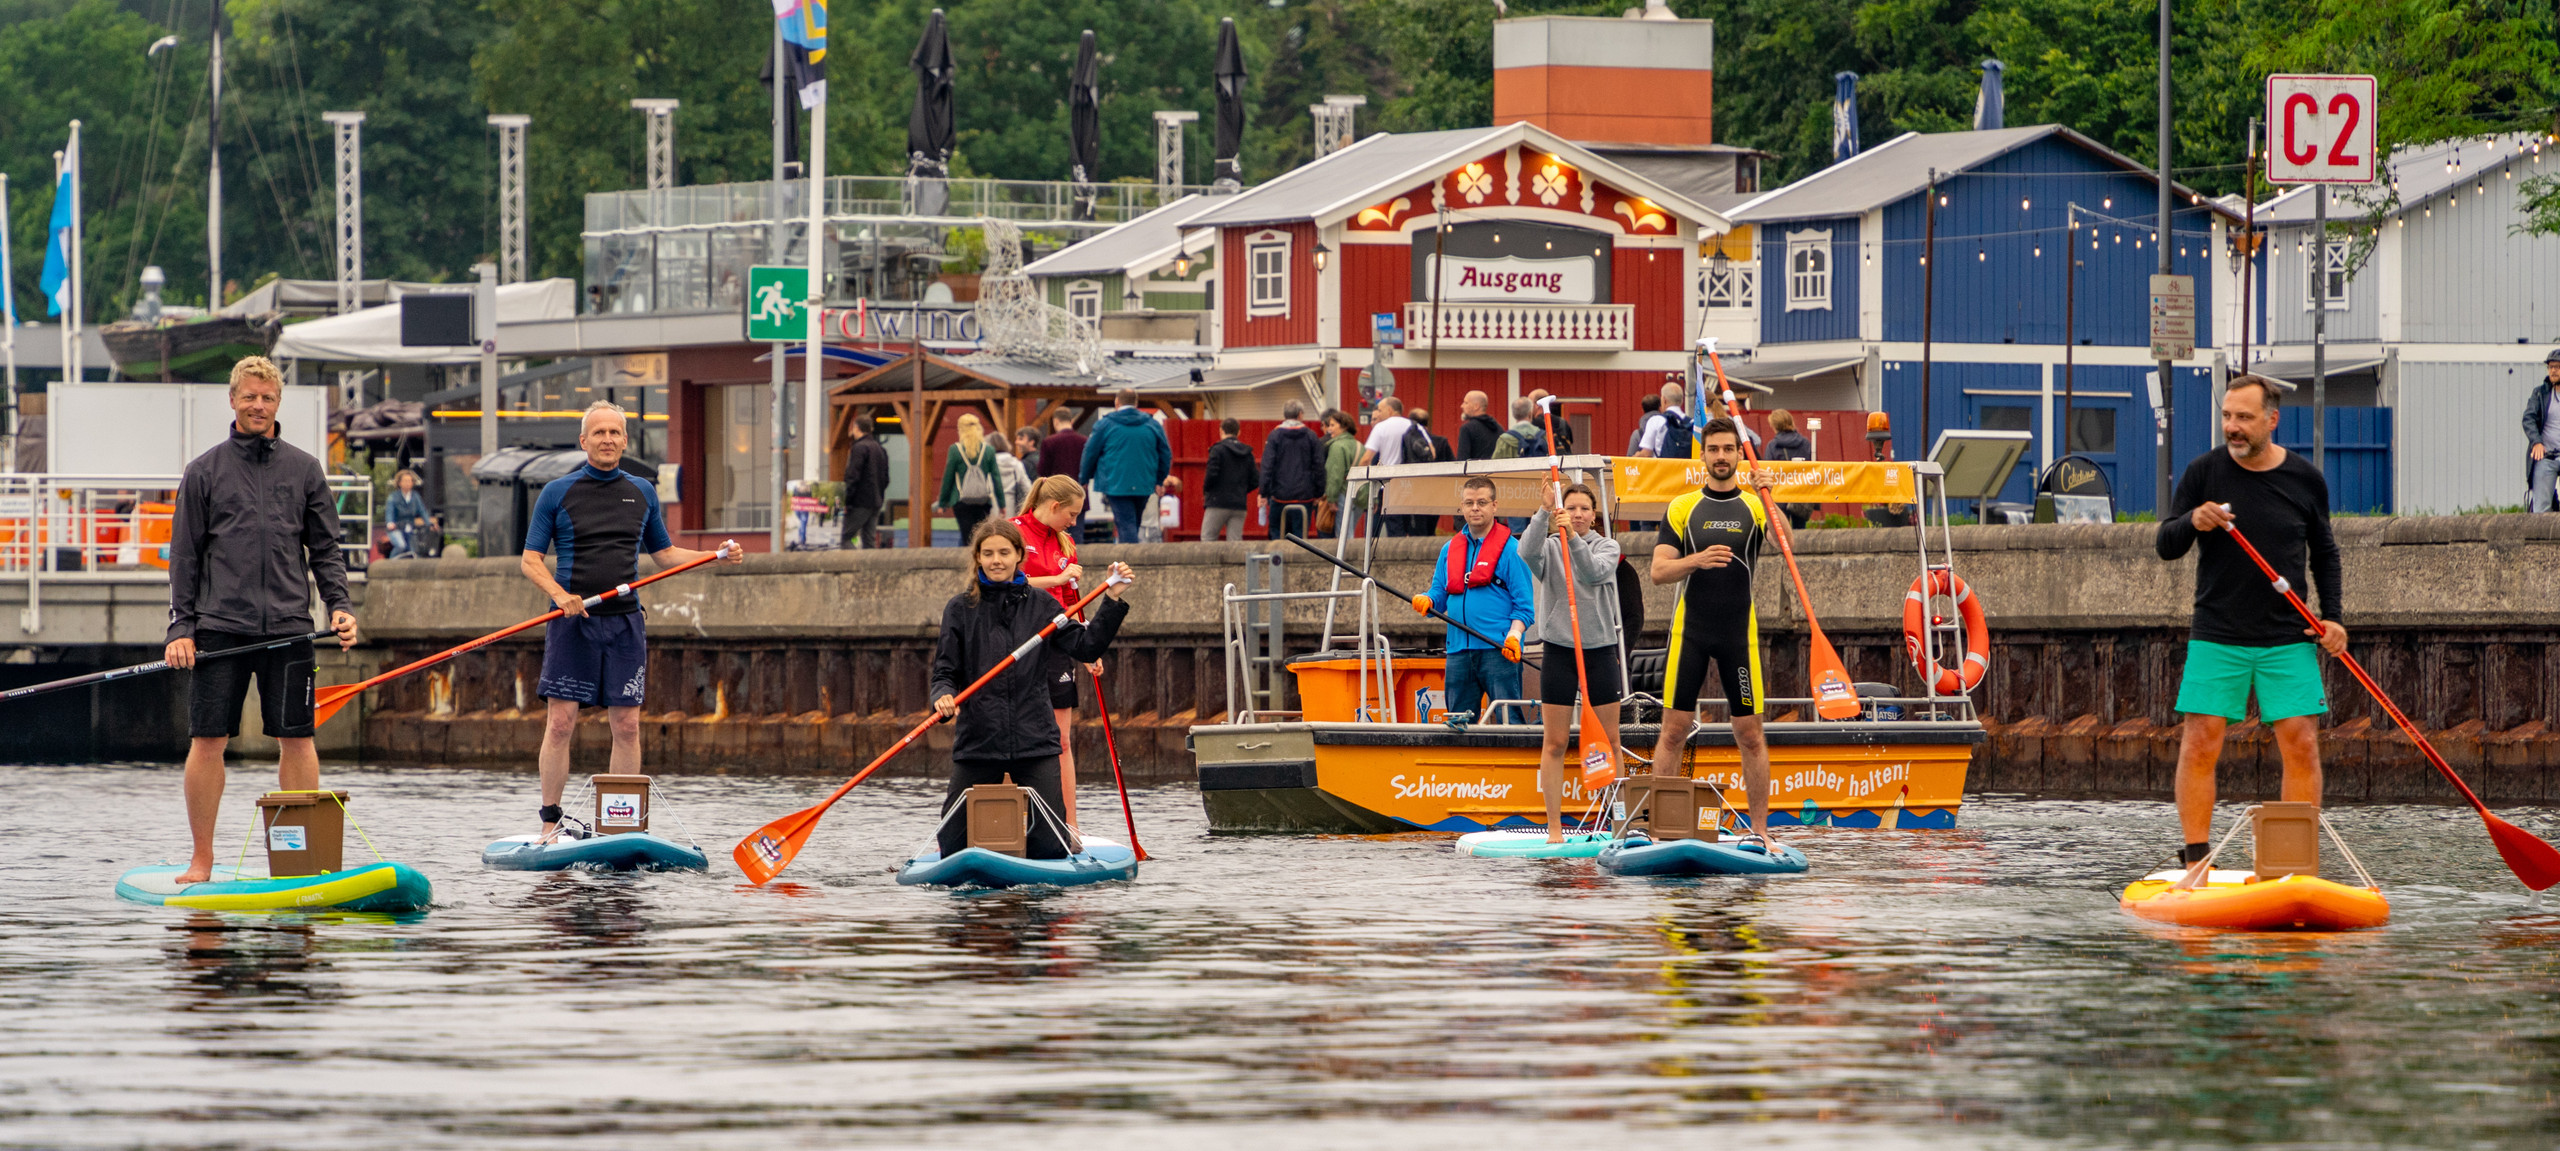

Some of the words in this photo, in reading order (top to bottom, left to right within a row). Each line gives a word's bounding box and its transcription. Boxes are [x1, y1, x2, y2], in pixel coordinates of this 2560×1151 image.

[2284, 92, 2360, 166] C2
[1459, 266, 1563, 294] Ausgang
[820, 297, 986, 342] rdwind
[1824, 467, 1845, 486] Kiel
[1703, 520, 1742, 530] PEGASO
[140, 661, 168, 673] FANATIC
[1737, 666, 1753, 707] PEGASO
[1860, 710, 1898, 720] TOATSU
[1390, 774, 1513, 800] Schiermoker
[1730, 772, 1779, 796] scn
[1764, 764, 1845, 792] sauber
[1849, 760, 1912, 797] halten!
[1703, 809, 1719, 820] ABK
[301, 891, 324, 903] FANATIC
